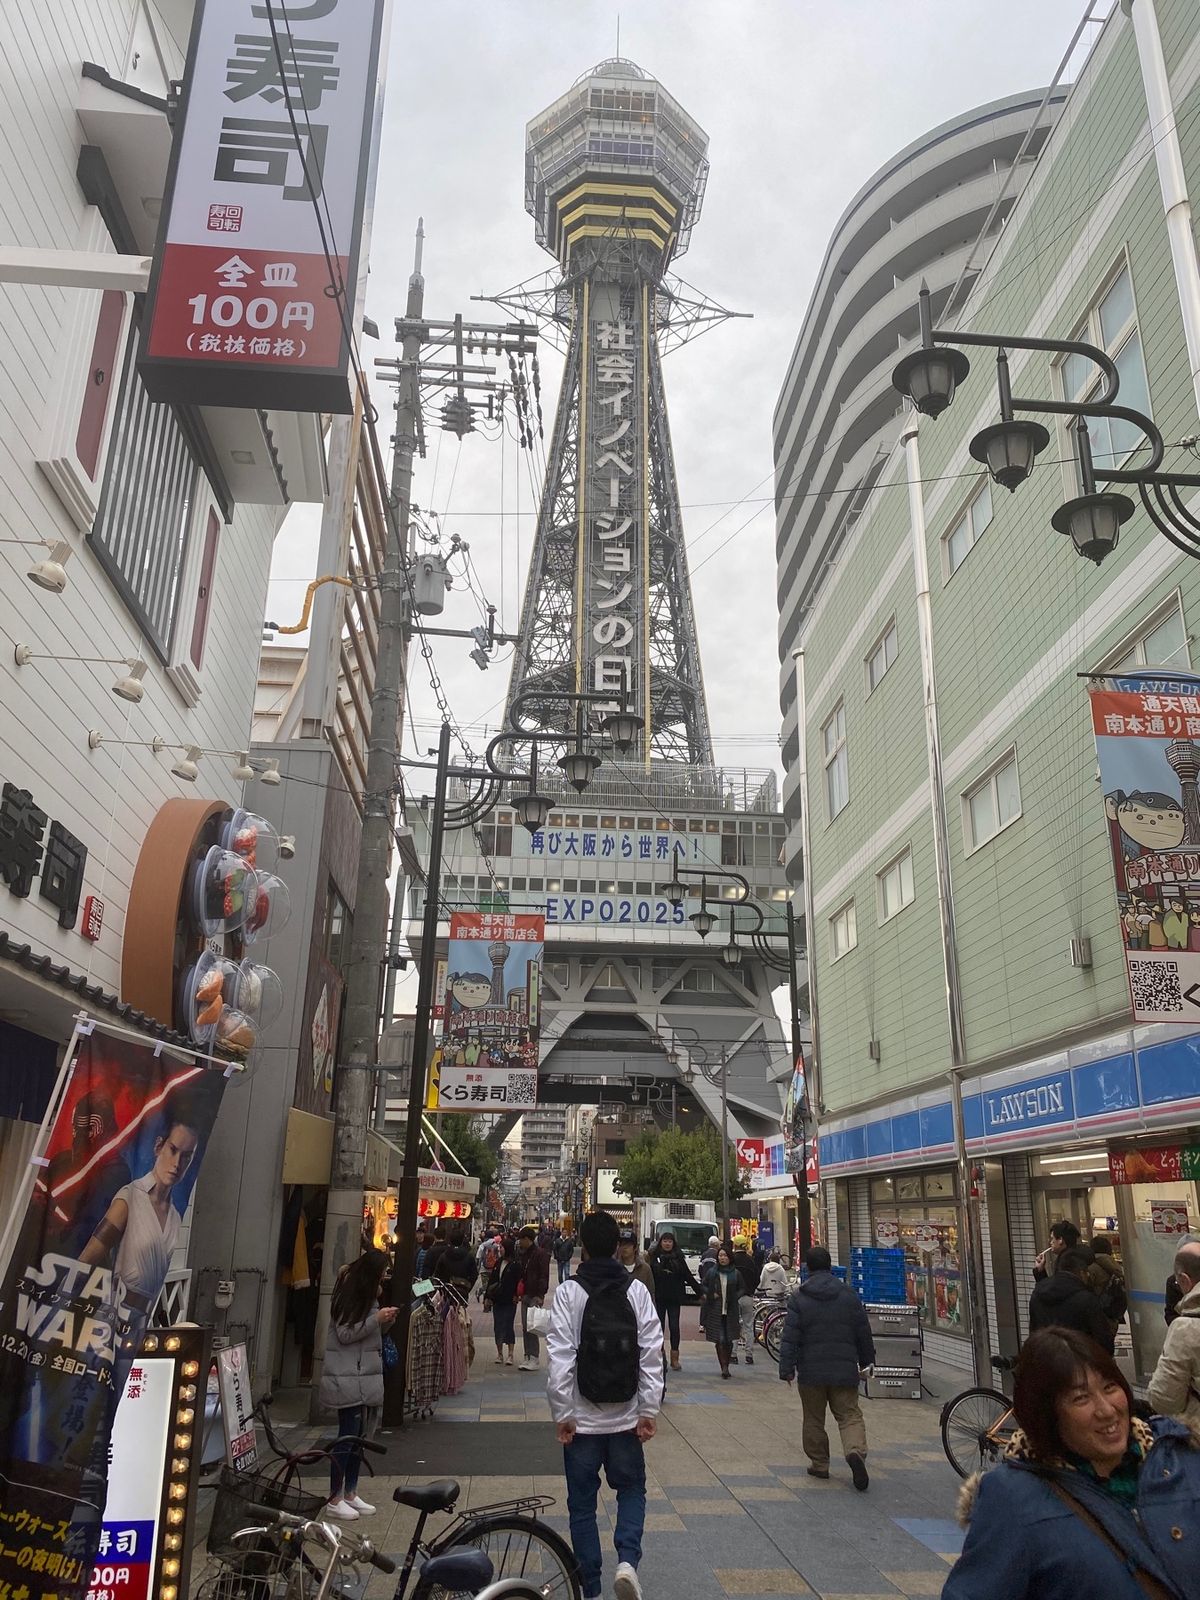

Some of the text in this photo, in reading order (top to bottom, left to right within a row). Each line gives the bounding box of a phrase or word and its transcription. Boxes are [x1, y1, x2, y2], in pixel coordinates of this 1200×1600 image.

[214, 255, 298, 288] 全皿
[188, 293, 315, 332] 100円
[186, 332, 306, 359] (税抜価格)
[480, 914, 516, 927] 通天閣
[546, 898, 685, 924] EXPO2025
[456, 926, 538, 940] 南本通り商店会
[440, 1085, 507, 1102] くら寿司
[988, 1083, 1065, 1125] LAWSON
